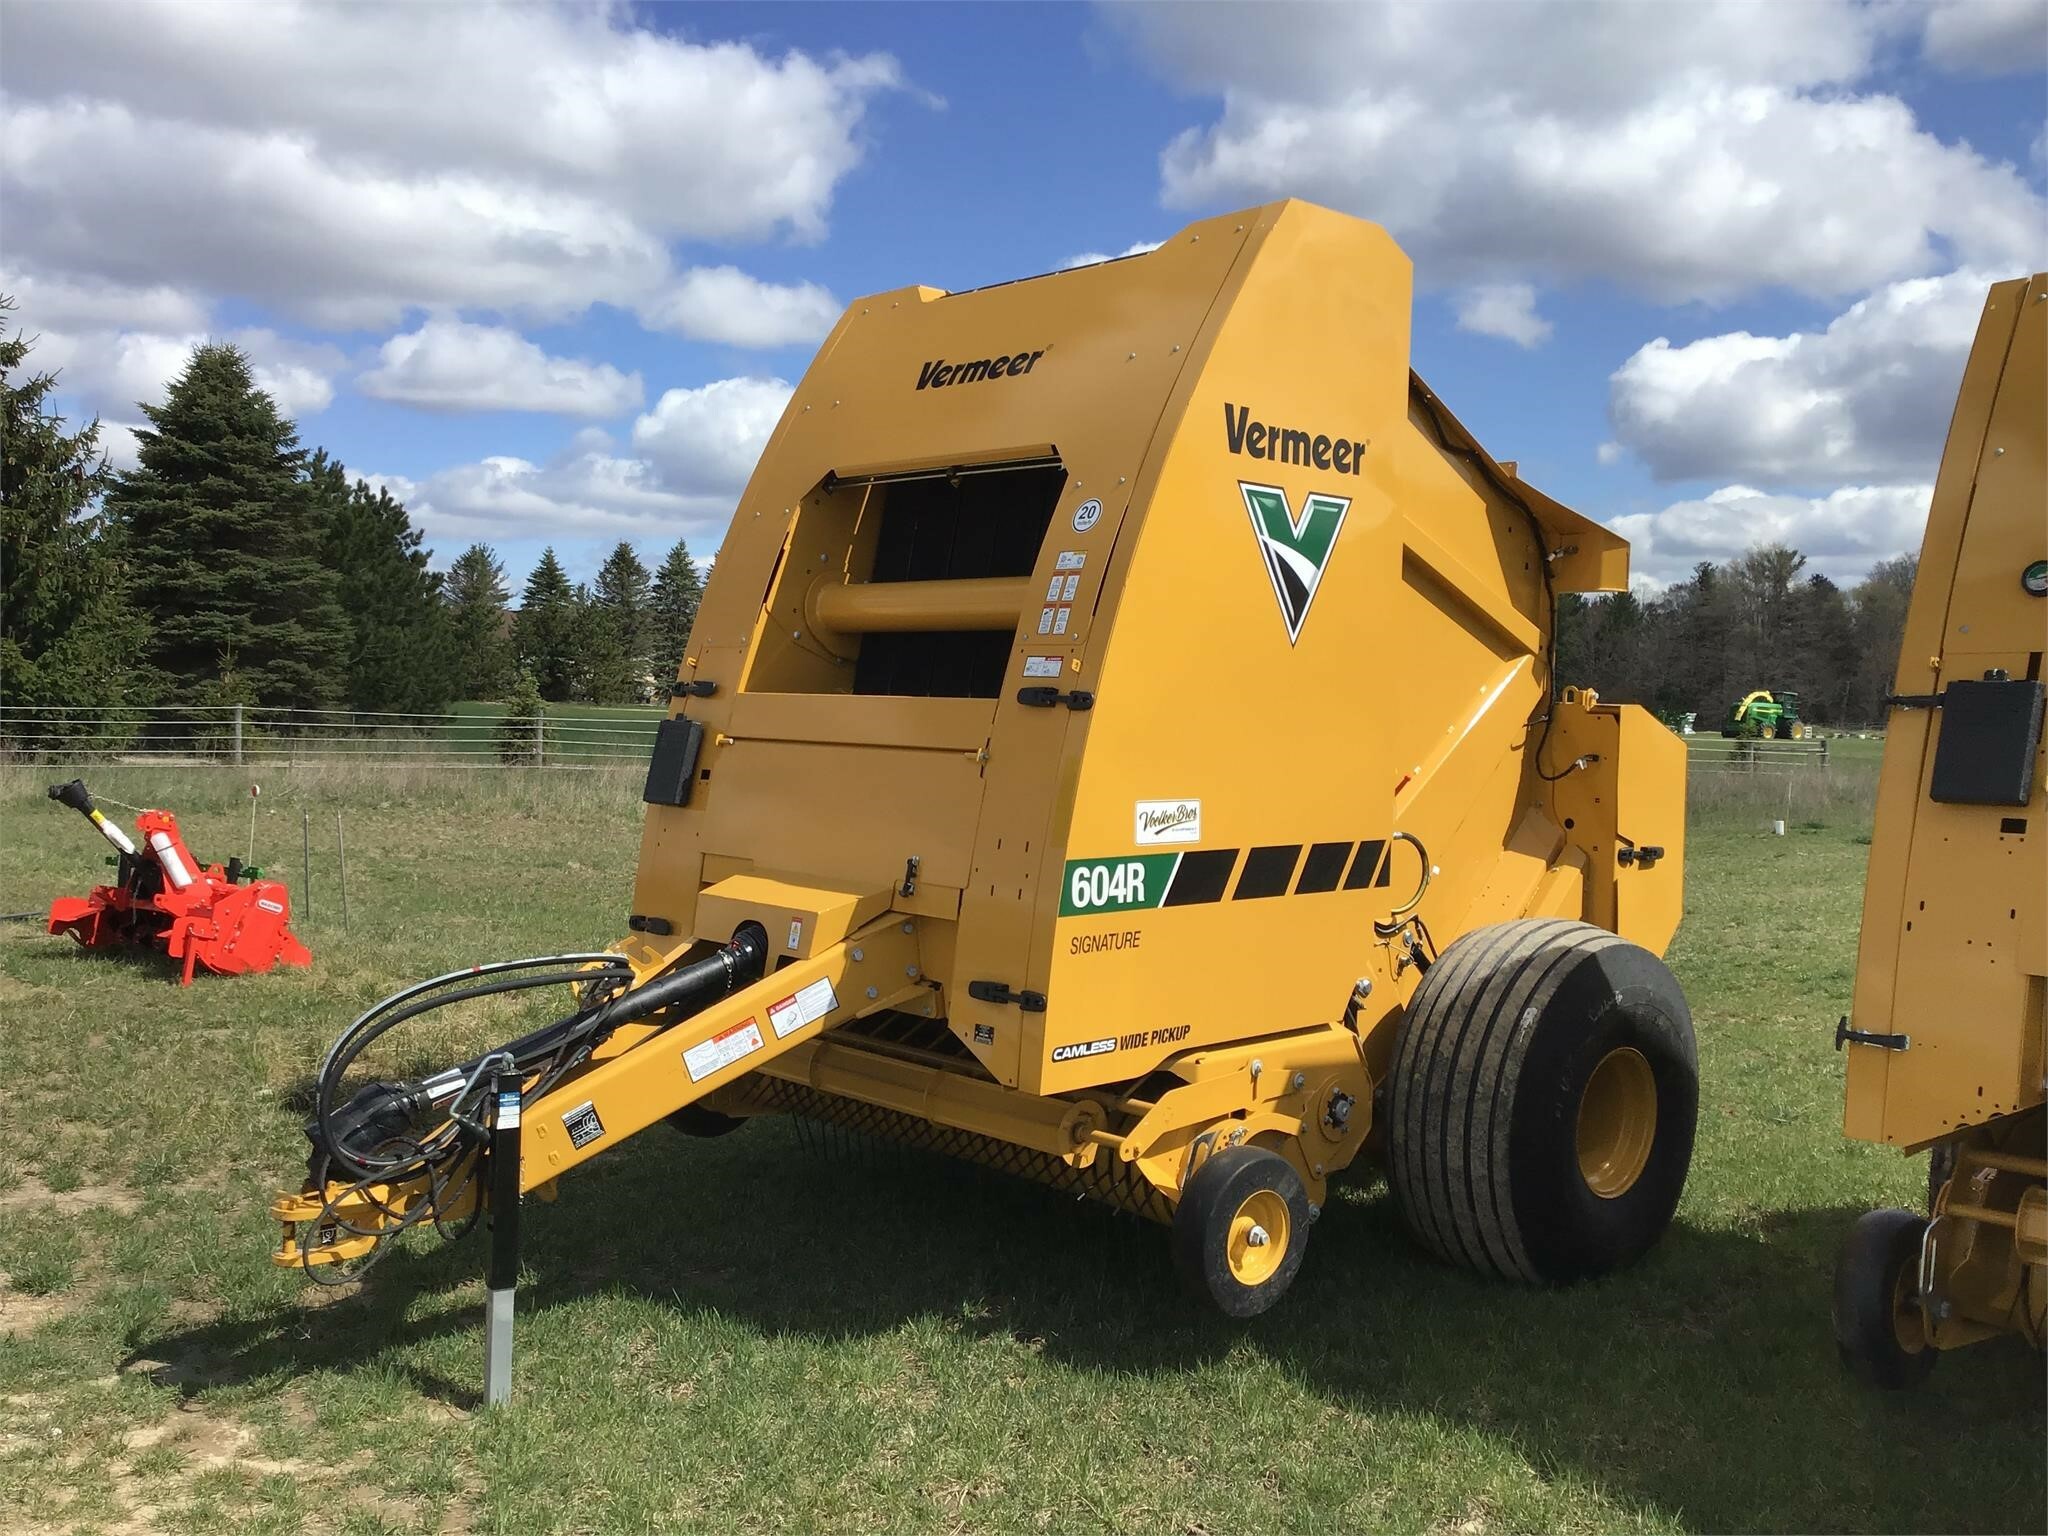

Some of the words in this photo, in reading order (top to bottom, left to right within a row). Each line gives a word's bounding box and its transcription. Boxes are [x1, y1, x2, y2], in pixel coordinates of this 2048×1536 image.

[916, 349, 1045, 391] Vermeer
[1224, 402, 1366, 476] Vermeer
[1079, 505, 1096, 519] 20
[1071, 862, 1146, 908] 604R
[1070, 930, 1142, 955] SIGNATURE
[1053, 1038, 1116, 1061] CAMLESS
[1120, 1031, 1149, 1051] WIDE
[1150, 1024, 1191, 1046] PICKUP
